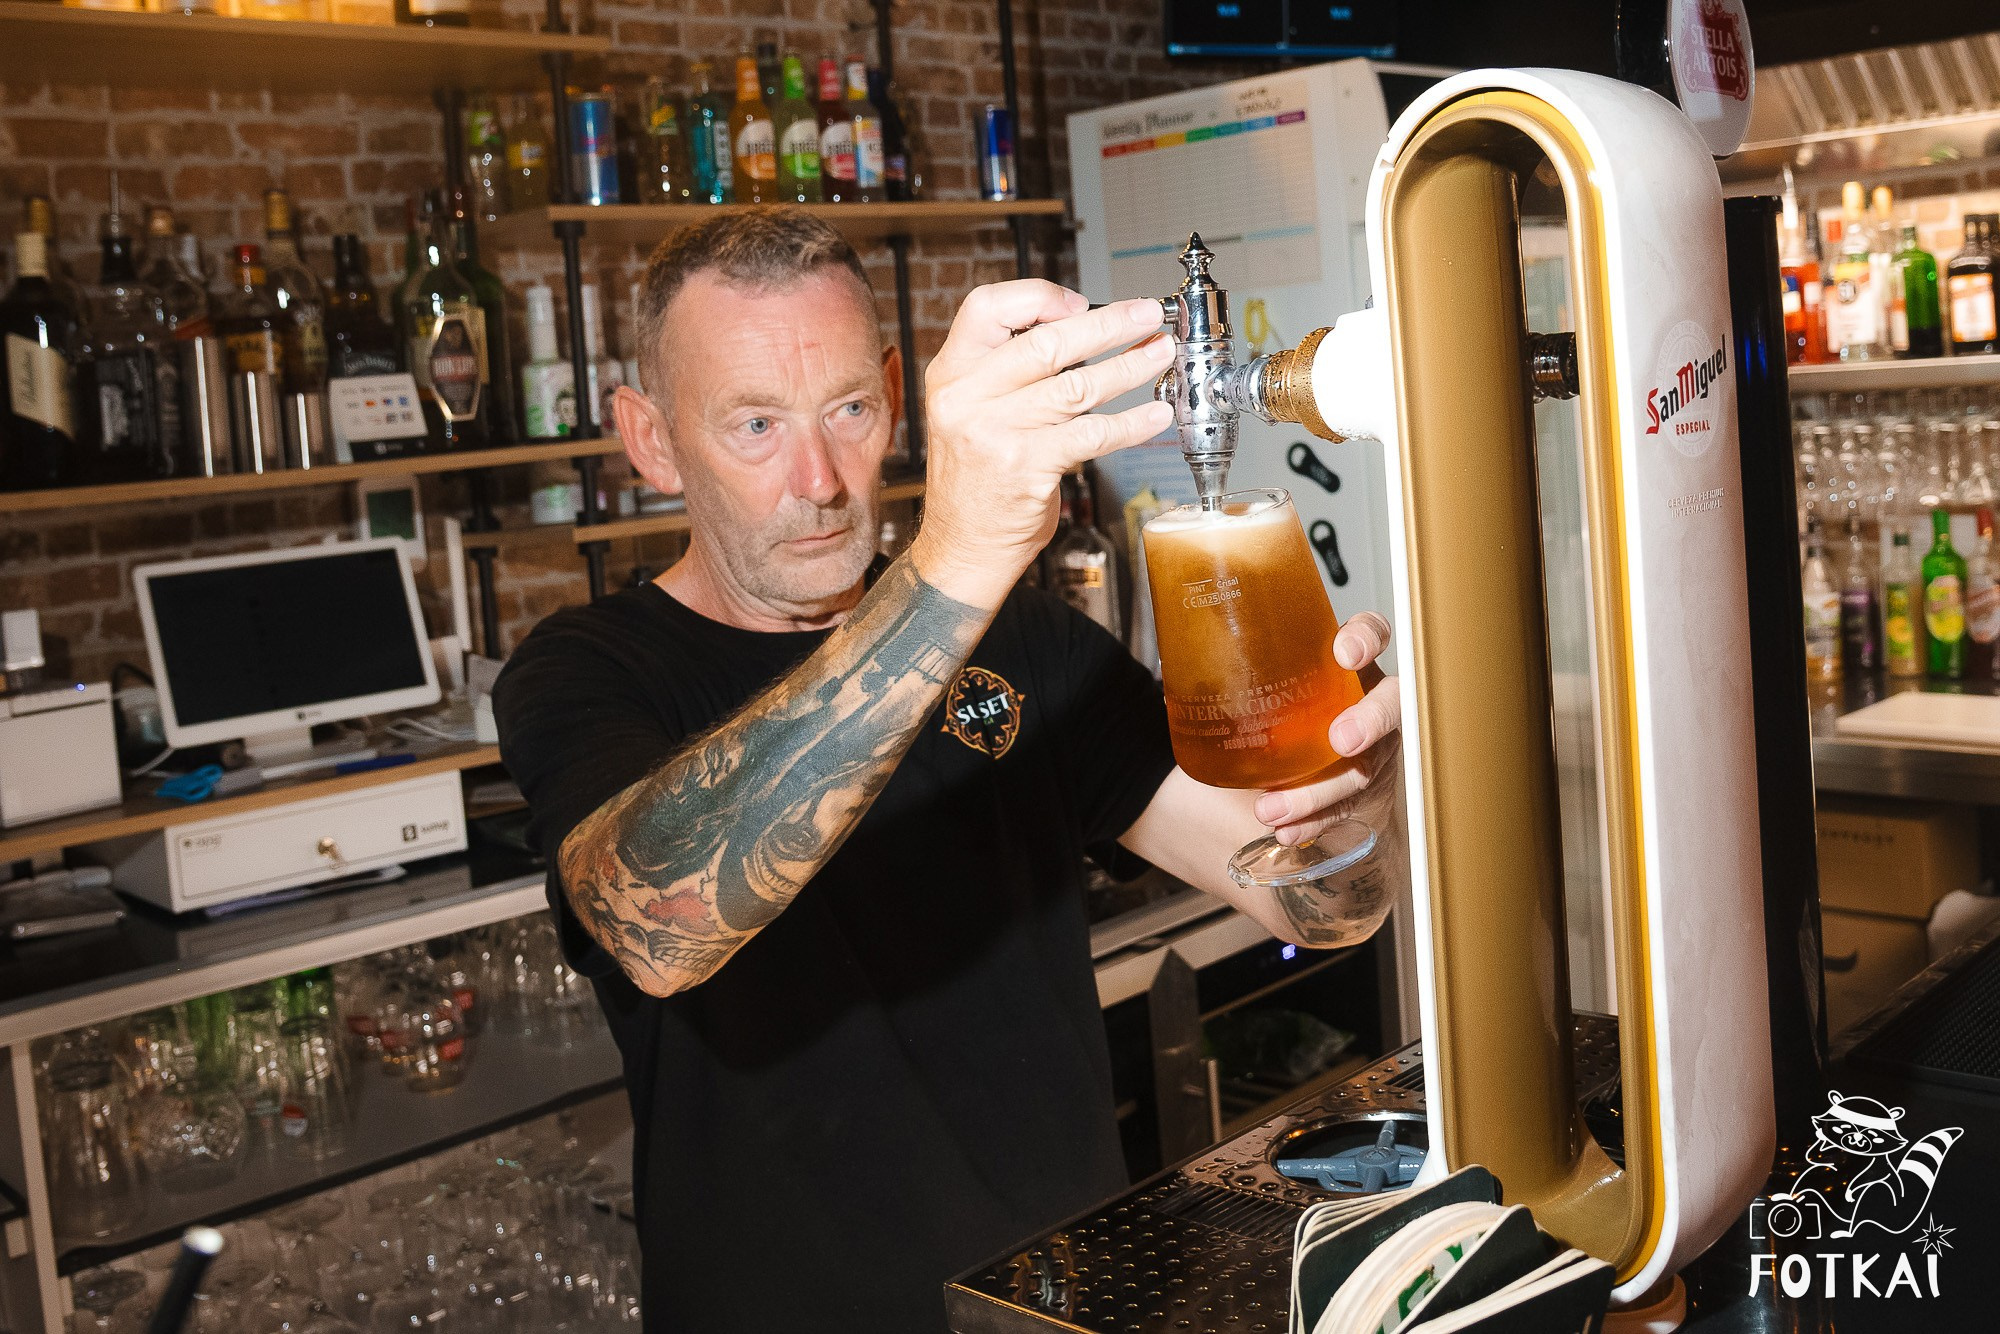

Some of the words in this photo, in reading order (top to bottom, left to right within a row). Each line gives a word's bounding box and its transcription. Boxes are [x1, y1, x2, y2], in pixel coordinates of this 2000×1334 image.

[1690, 23, 1735, 53] STELLA
[1693, 50, 1738, 78] ARTOIS
[1675, 420, 1711, 436] ESPECIAL
[1188, 584, 1206, 594] PINT
[1216, 576, 1239, 588] Crisal
[1182, 693, 1231, 703] CERVEZA
[1238, 676, 1298, 697] PREMIUM
